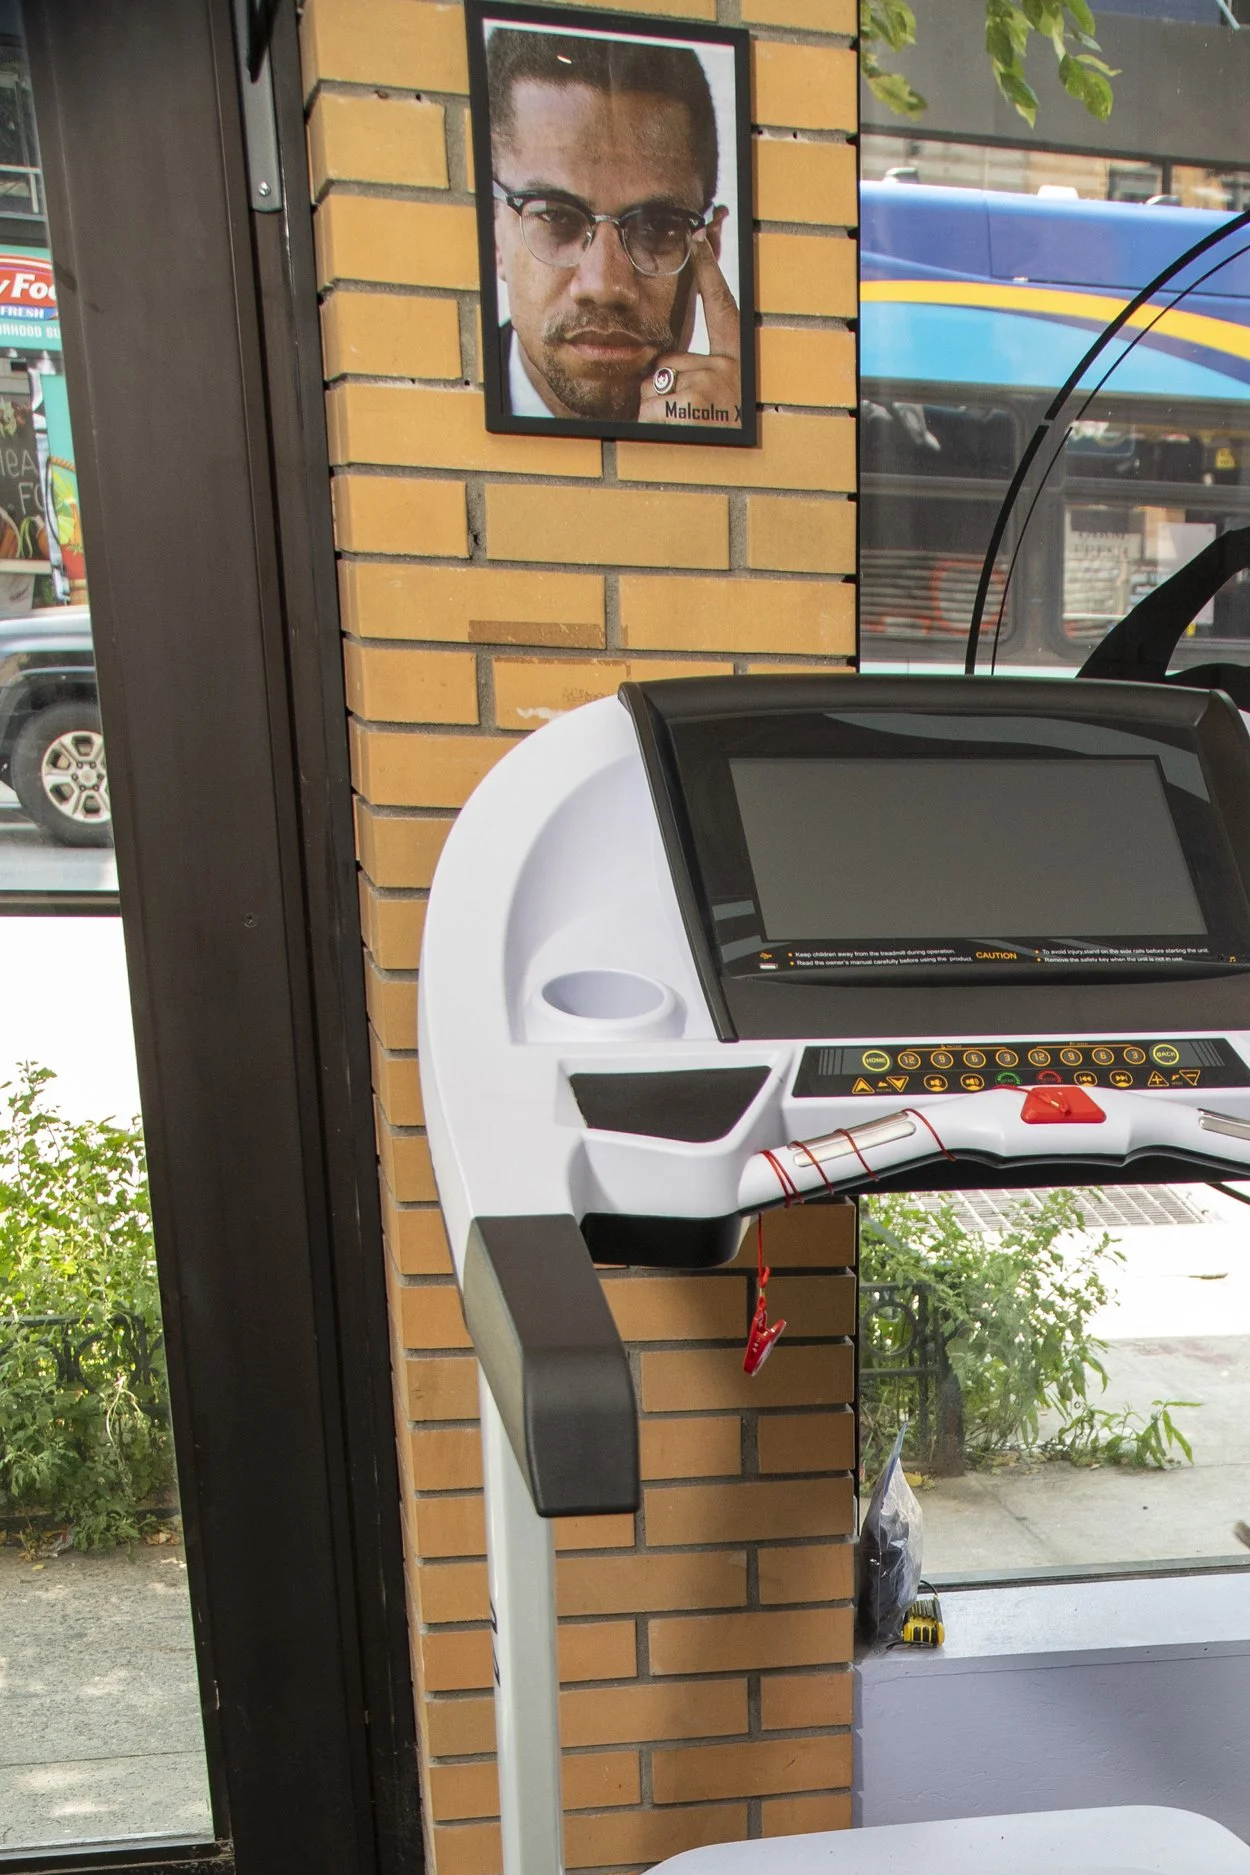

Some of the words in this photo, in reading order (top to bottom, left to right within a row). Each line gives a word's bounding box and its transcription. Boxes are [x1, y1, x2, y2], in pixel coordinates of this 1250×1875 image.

[665, 401, 729, 422] Malcolm
[975, 951, 1018, 960] CAUTION
[866, 1056, 886, 1064] HOME
[902, 1055, 915, 1065] 12
[939, 1055, 946, 1063] 9
[971, 1054, 978, 1063] 6
[1004, 1053, 1011, 1062] 3
[1033, 1052, 1045, 1061] 12
[1068, 1052, 1074, 1060] 9
[1100, 1051, 1106, 1060] 6
[1131, 1051, 1138, 1059] 3
[1156, 1051, 1176, 1059] BACK
